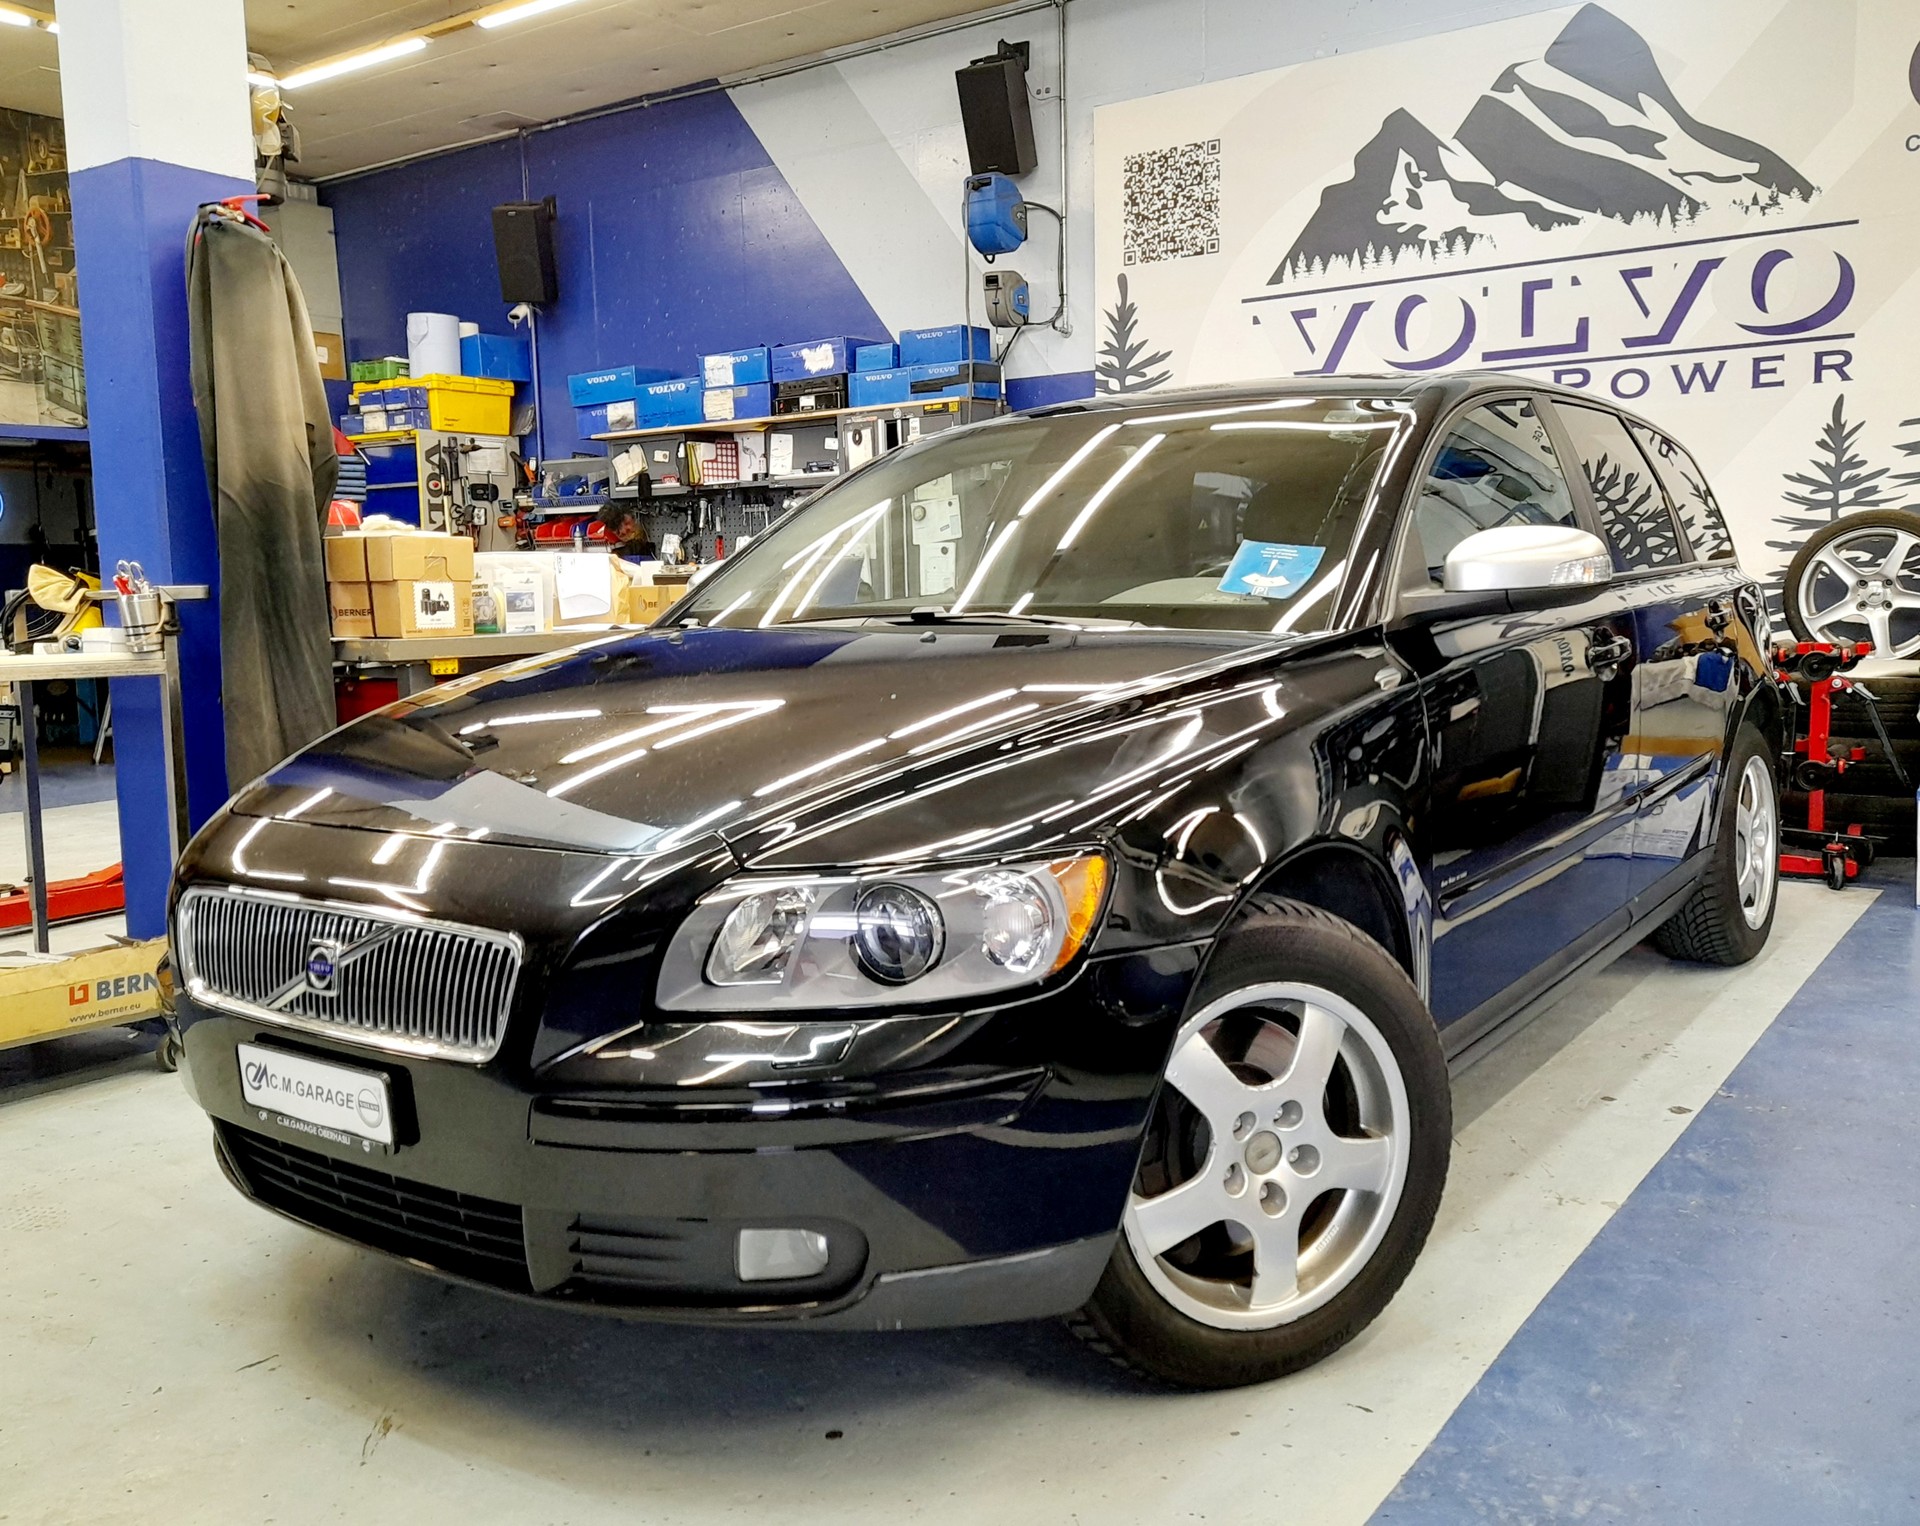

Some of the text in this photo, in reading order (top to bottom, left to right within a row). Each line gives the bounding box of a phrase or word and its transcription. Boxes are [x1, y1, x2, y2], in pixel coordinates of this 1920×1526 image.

[1251, 240, 1856, 375] VOLVO
[915, 331, 943, 340] VOLVO
[928, 366, 956, 375] VOLVO
[1551, 350, 1855, 400] POWER
[586, 374, 616, 385] VOLVO
[865, 373, 893, 382] VOLVO
[647, 382, 686, 395] VOLVO
[70, 1003, 141, 1023] www.berner.eu
[269, 1076, 354, 1110] C.M.GARAGE
